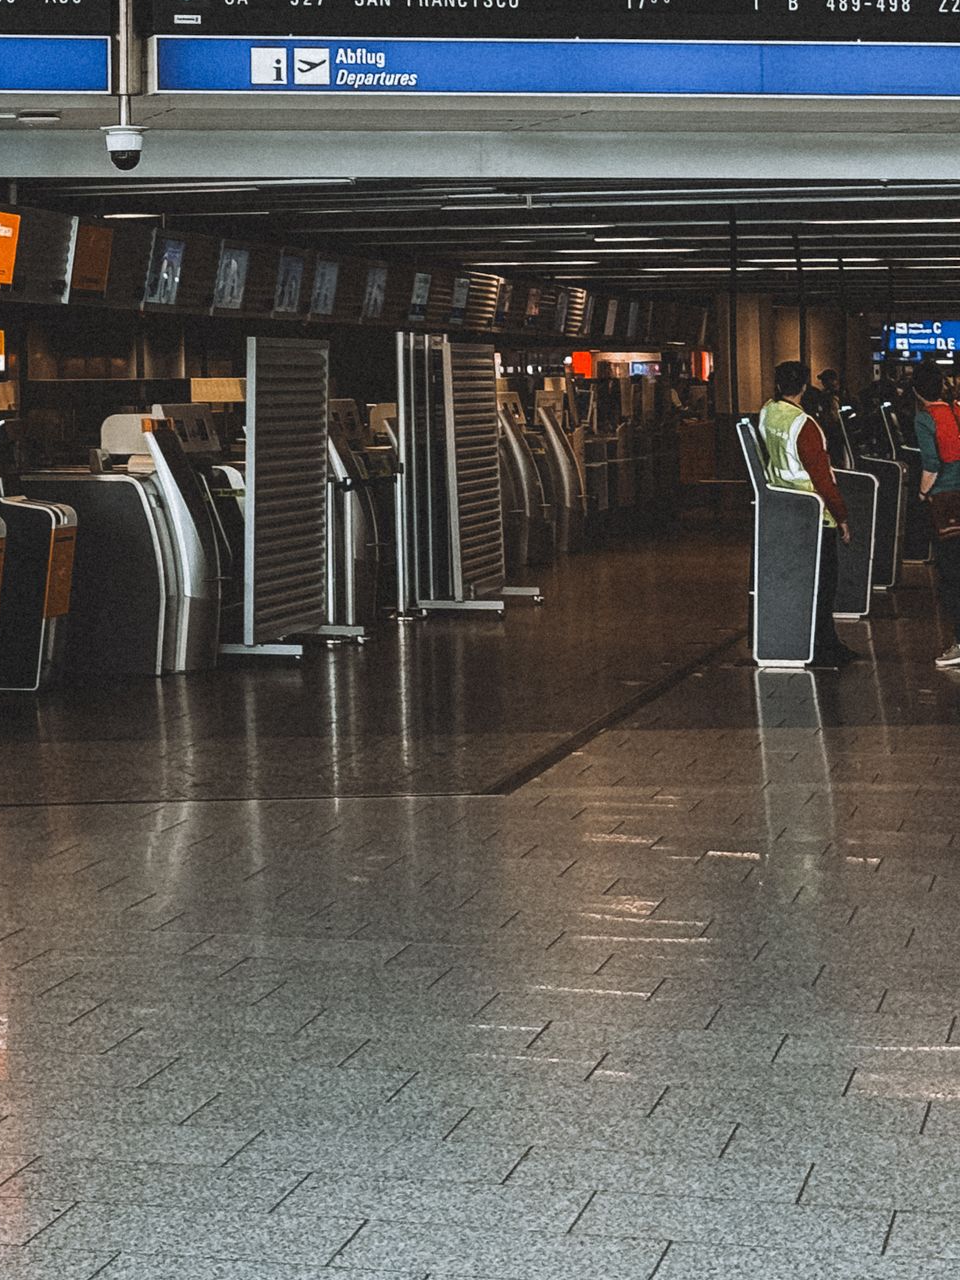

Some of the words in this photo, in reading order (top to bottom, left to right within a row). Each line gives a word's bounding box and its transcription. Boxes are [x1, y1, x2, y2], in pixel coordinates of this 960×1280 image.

[336, 49, 384, 67] Abflug
[337, 70, 417, 88] Departures
[933, 322, 942, 334] C
